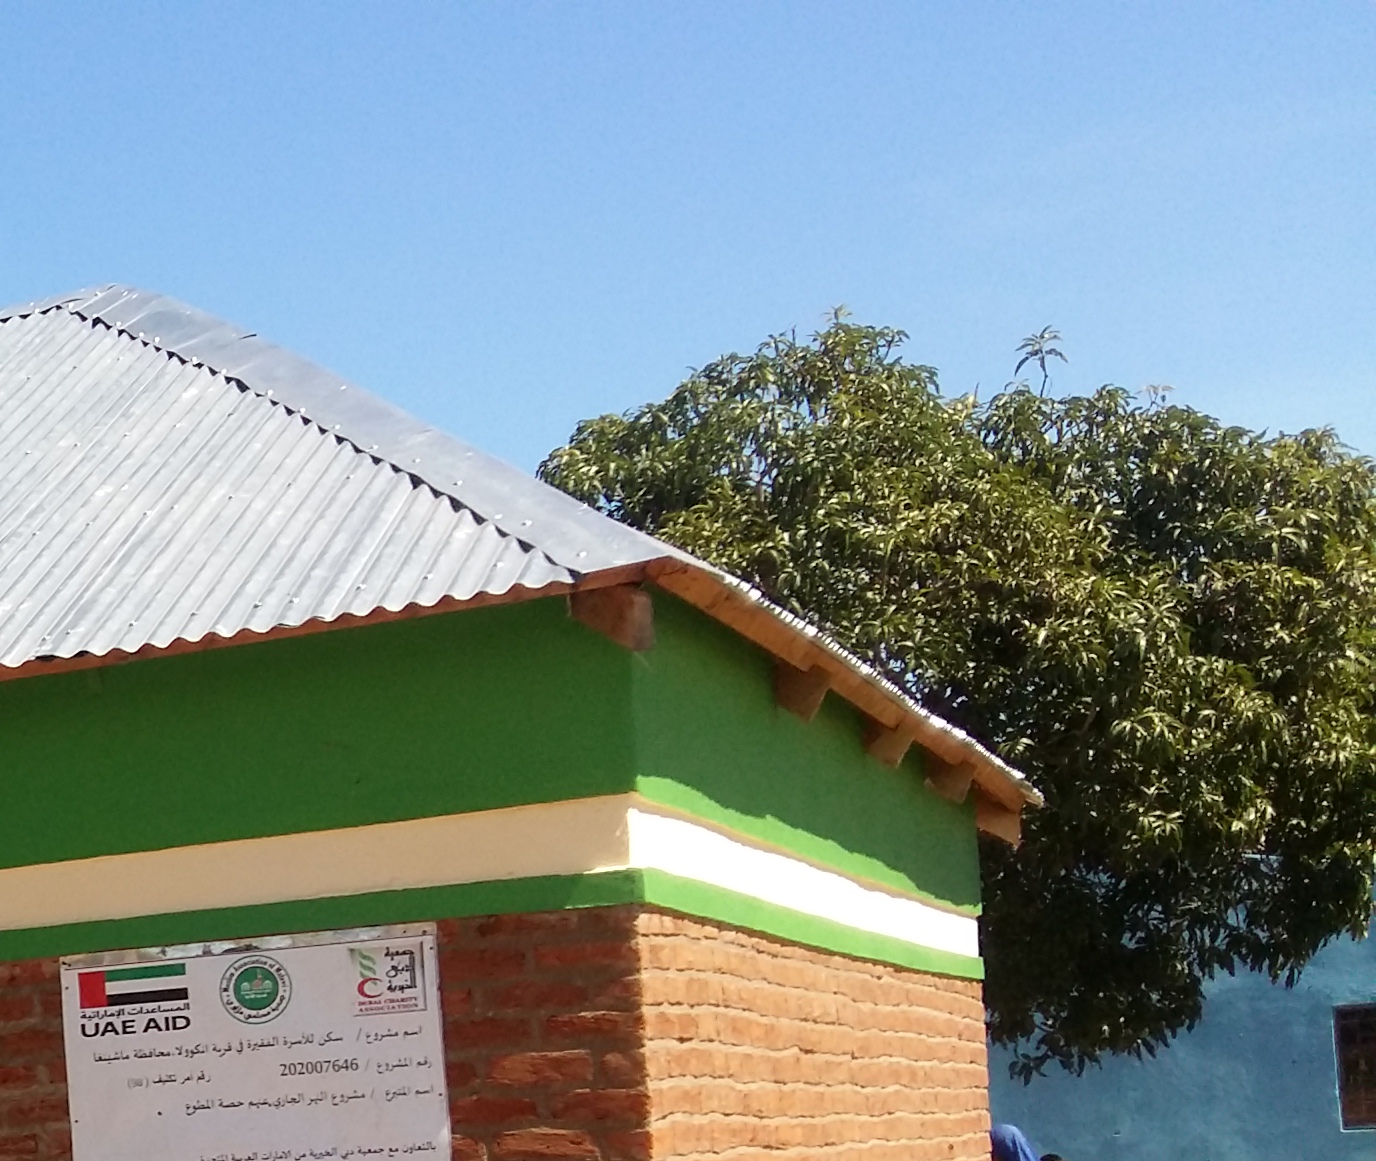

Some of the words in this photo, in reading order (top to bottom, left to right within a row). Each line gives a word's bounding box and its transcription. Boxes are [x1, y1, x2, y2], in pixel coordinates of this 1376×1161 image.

[80, 1008, 125, 1021] الإماراتية
[128, 1002, 190, 1016] المساعدات
[80, 1019, 137, 1038] UAE
[142, 1015, 191, 1033] AID
[403, 1026, 422, 1039] اسم
[318, 1032, 343, 1046] سكن
[366, 1028, 398, 1044] مشروع
[279, 1058, 359, 1077] 202007646
[376, 1058, 412, 1074] المشروع
